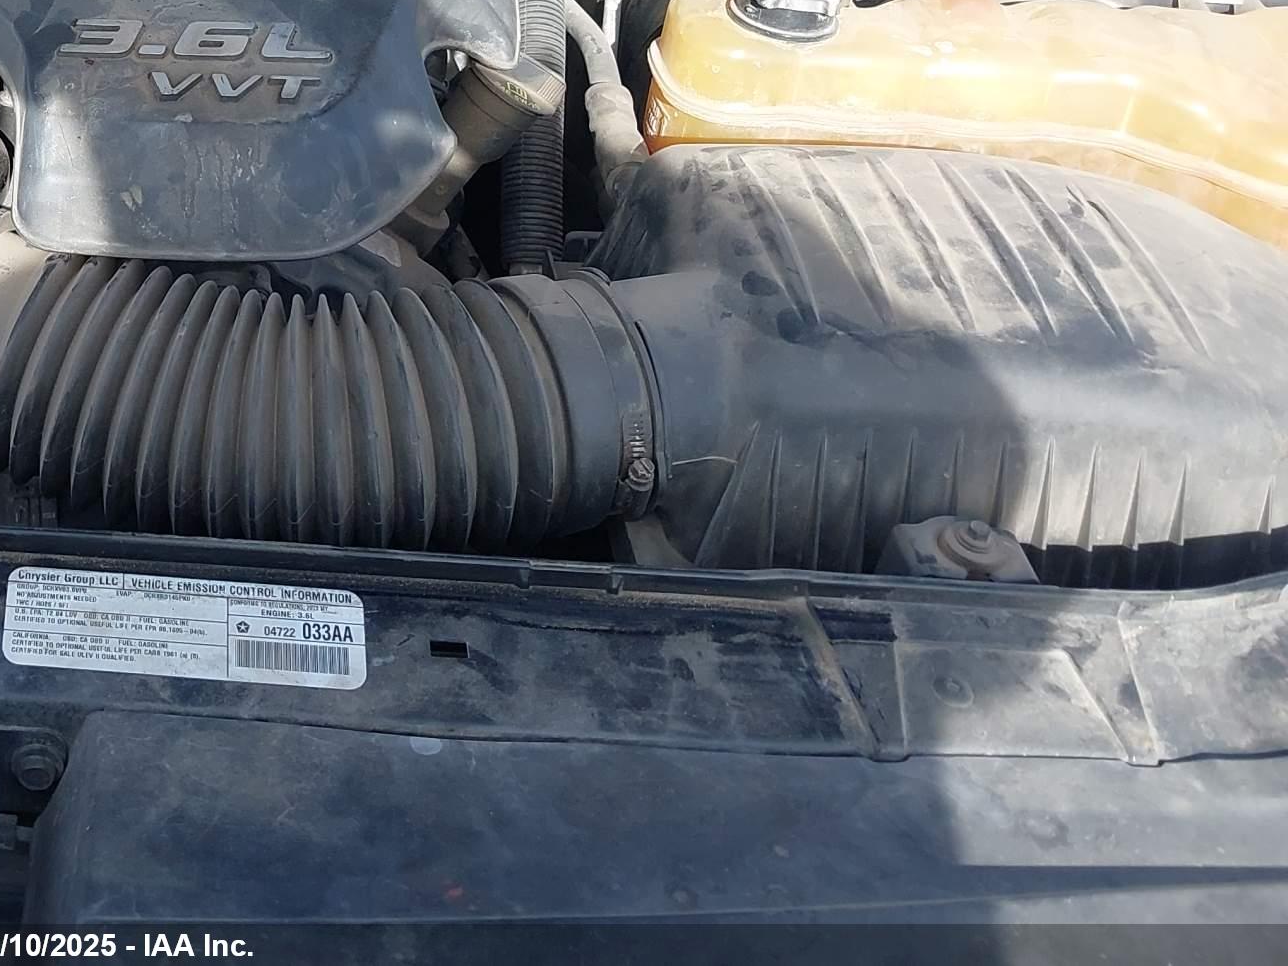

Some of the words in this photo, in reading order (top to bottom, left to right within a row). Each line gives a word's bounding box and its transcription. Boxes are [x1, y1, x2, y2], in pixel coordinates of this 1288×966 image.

[58, 17, 334, 62] 3.6L
[149, 72, 321, 102] VVT
[18, 570, 60, 582] Chrysler
[64, 574, 95, 586] Group
[99, 576, 118, 586] LLC
[26, 592, 71, 600] ADJUSTMENTS
[131, 578, 172, 591] VEHICLE
[177, 580, 226, 594] EMISSION
[229, 585, 277, 599] CONTROL
[281, 588, 352, 604] INFORMATION
[14, 615, 45, 623] CERTIFIED
[57, 618, 87, 627] OPTIONAL
[89, 620, 113, 628] USEFUL
[139, 616, 156, 624] FUEL:
[159, 618, 189, 626] GASOLINE
[261, 609, 295, 619] ENGINE:
[297, 612, 314, 620] 3.6L
[264, 625, 296, 638] 04722
[302, 622, 353, 643] 033AA
[12, 639, 44, 647] CERTIFIED
[56, 642, 85, 651] OPTIONAL
[89, 644, 112, 653] USEFUL
[138, 641, 168, 649] GASOLINE
[11, 646, 43, 655] CERTIFIED
[101, 653, 136, 661] QUALIFIED.
